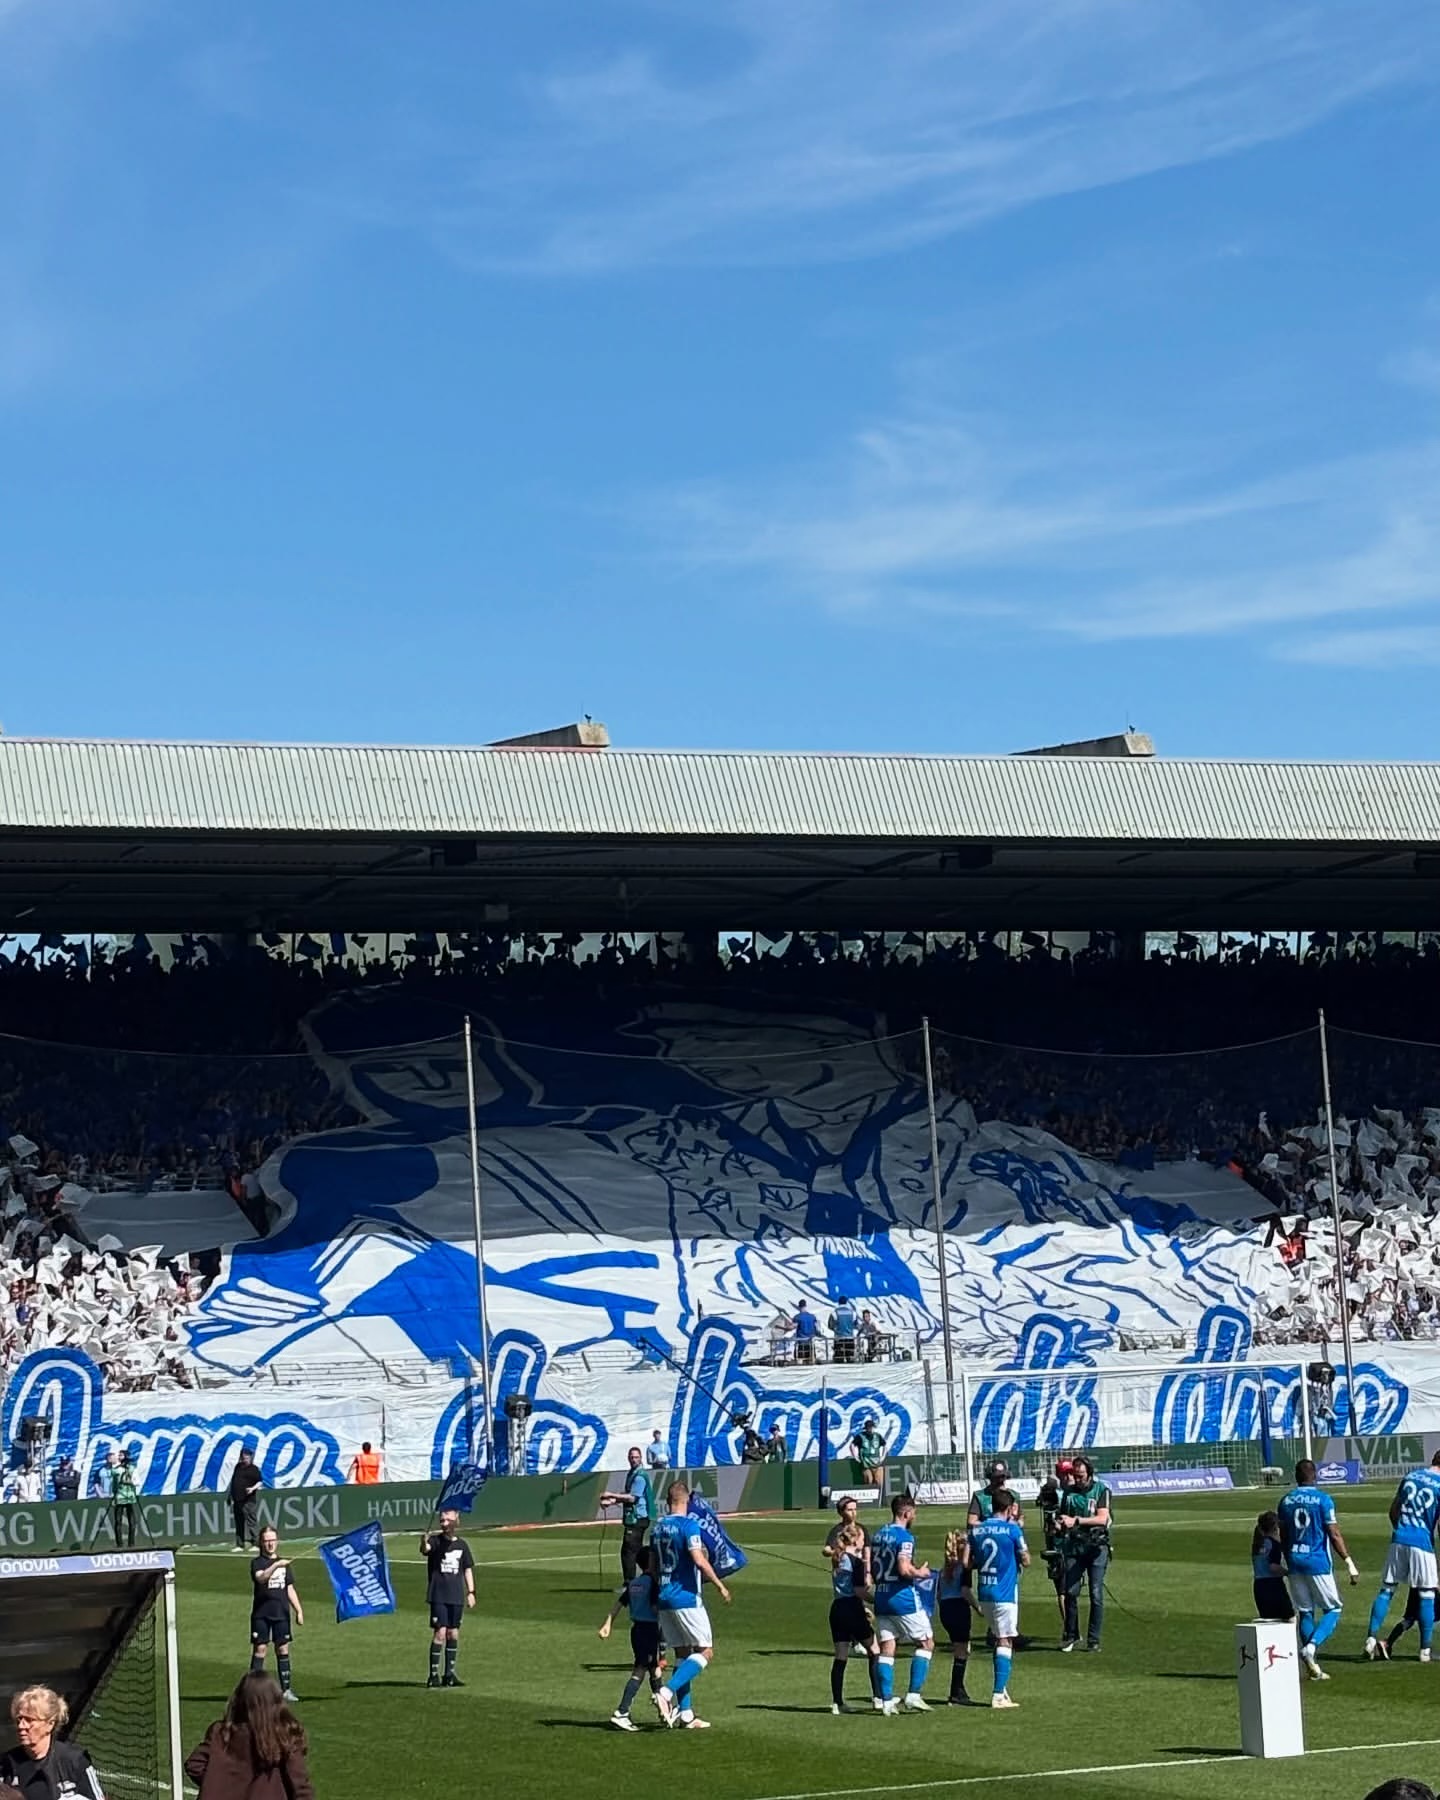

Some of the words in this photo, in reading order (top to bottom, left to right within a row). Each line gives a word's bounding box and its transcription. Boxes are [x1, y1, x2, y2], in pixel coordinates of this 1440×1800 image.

[1294, 1508, 1311, 1541] 9
[981, 1538, 998, 1573] 2
[332, 1543, 390, 1607] BOCHUM
